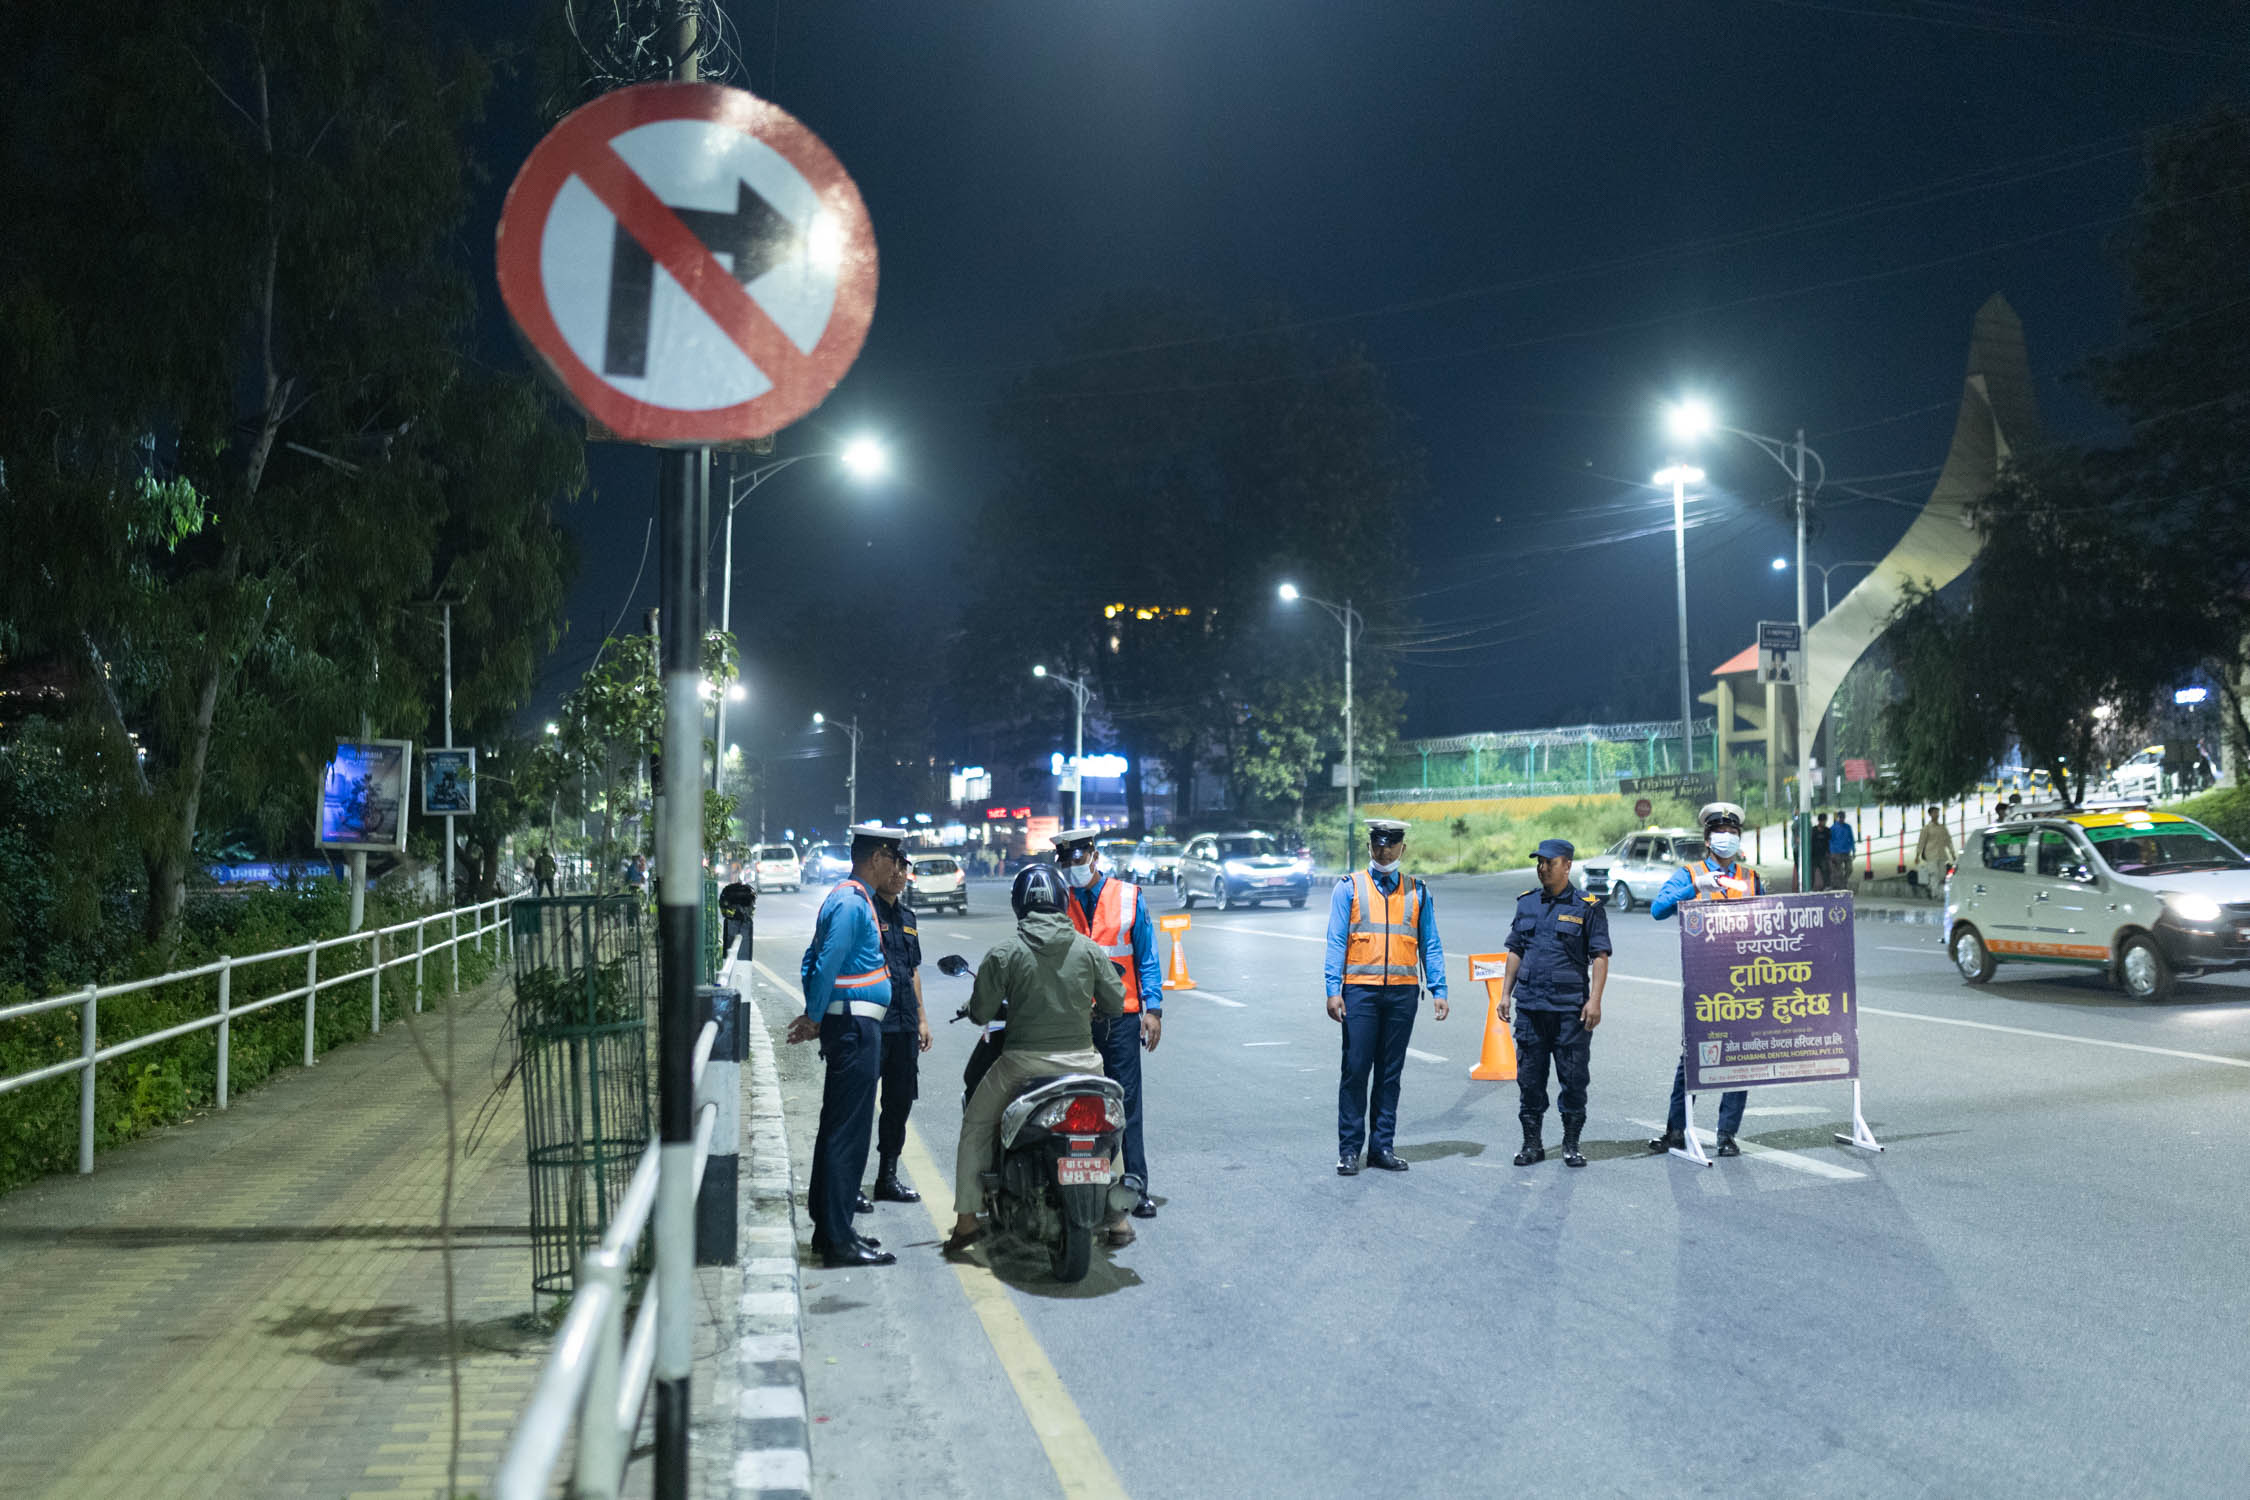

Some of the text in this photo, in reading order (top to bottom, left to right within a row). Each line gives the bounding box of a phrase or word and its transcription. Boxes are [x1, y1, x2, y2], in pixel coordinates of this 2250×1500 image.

[1705, 901, 1825, 942] ट्राफिक प्रहरी प्रभाग
[1736, 934, 1804, 954] एयरपोर्ट
[1729, 956, 1813, 993] ट्राफिक
[1694, 991, 1765, 1022] चेकिङ
[1768, 1051, 1790, 1059] DENTAL
[1791, 1049, 1820, 1057] HOSPITAL
